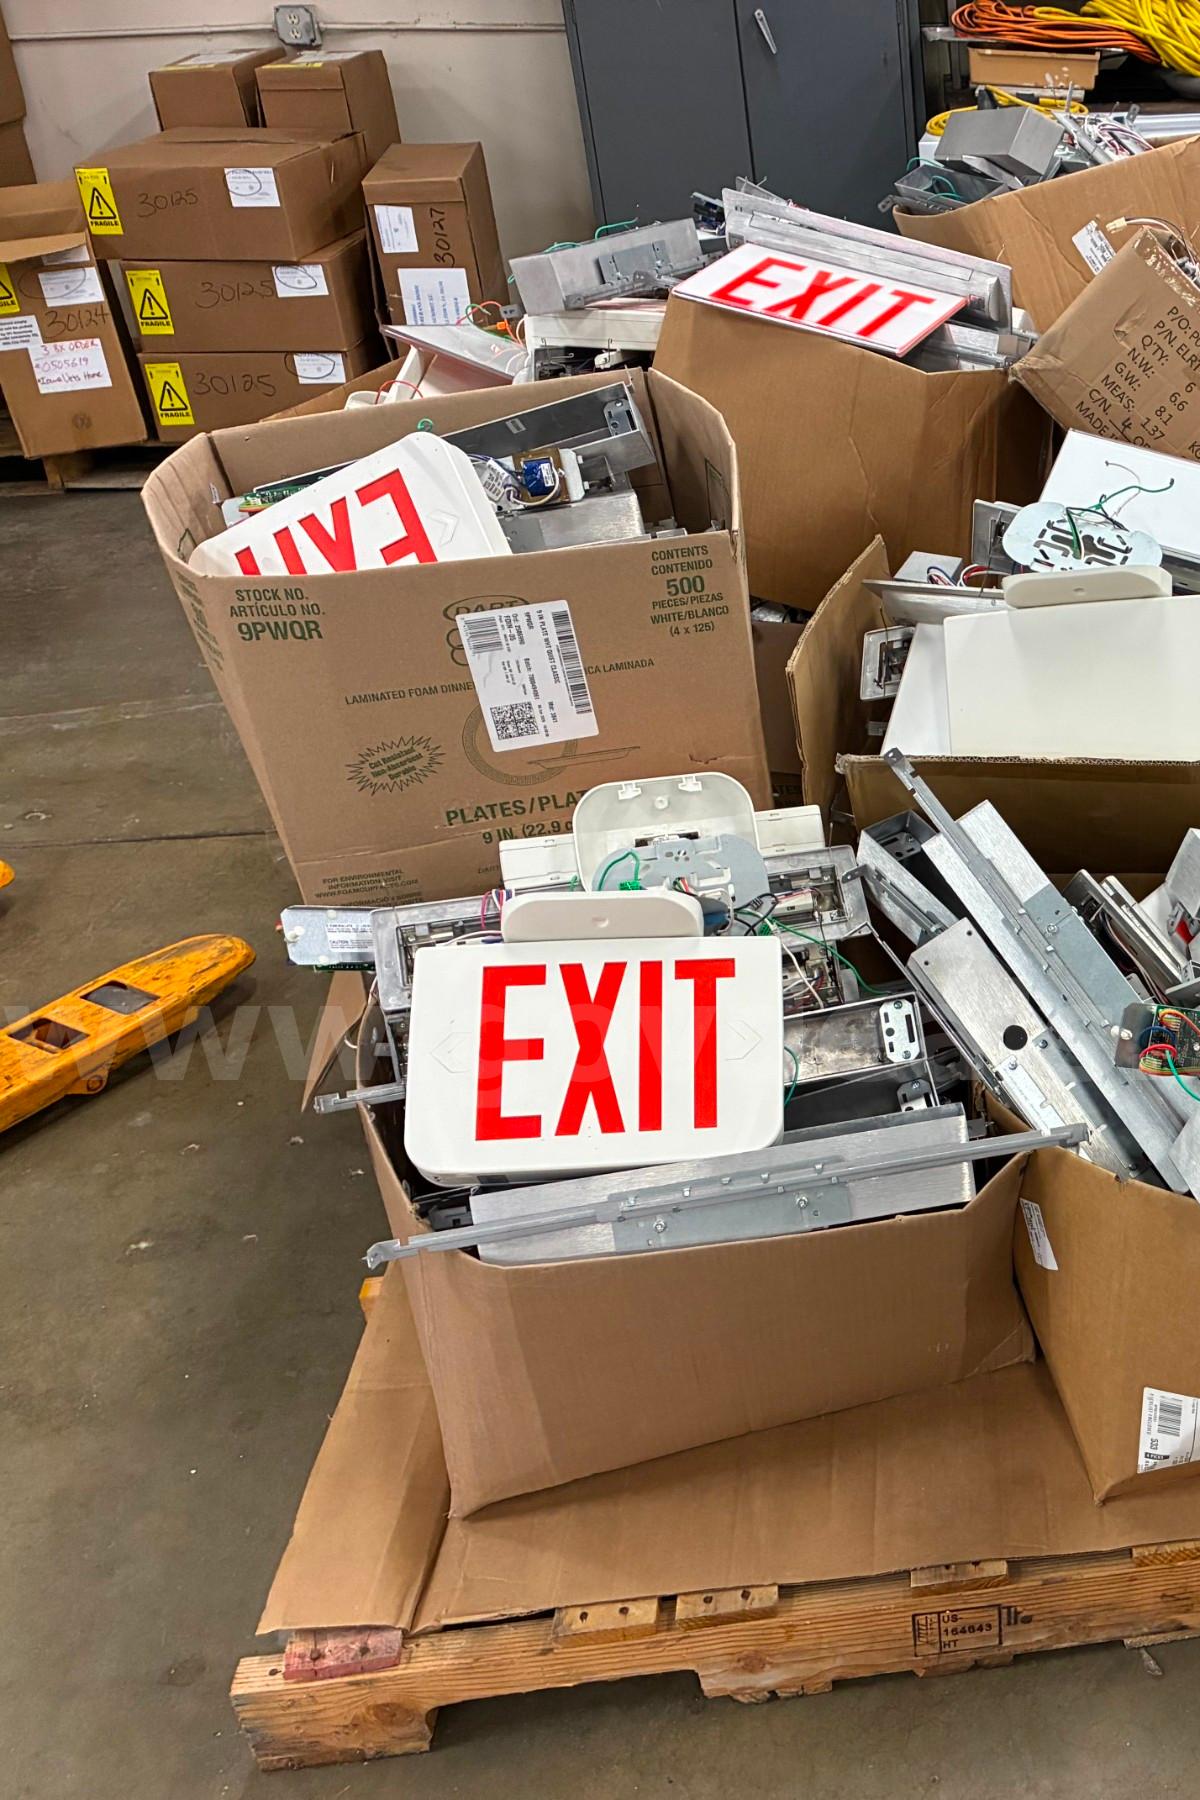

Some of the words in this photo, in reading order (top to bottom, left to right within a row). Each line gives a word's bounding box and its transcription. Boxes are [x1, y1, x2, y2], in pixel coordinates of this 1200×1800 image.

[137, 191, 198, 217] 30125
[430, 207, 455, 268] 30127
[196, 281, 275, 308] 30125
[710, 257, 934, 337] EXIT
[43, 303, 110, 338] 30124
[193, 371, 277, 397] 30125
[1184, 381, 1197, 394] 6
[1168, 391, 1189, 413] 6.6
[1075, 400, 1109, 435] MADE
[1154, 405, 1175, 427] 8.1
[1140, 416, 1166, 442] 1.37
[234, 469, 437, 576] EX
[651, 545, 709, 561] CONTENTS
[651, 558, 713, 576] CONTENIDO
[235, 588, 281, 601] STOCK
[284, 588, 309, 601] NO.
[666, 575, 705, 596] 500
[230, 602, 297, 618] ARTÍCULO
[301, 603, 326, 616] NO.
[456, 600, 518, 615] DAR
[651, 592, 724, 610] PIECES/PIEZAS
[650, 605, 729, 625] WHITE/BLANCO
[237, 620, 323, 641] 9PWQR
[694, 620, 715, 632] 125)
[603, 658, 655, 674] LAMINADA
[344, 684, 406, 705] LAMINATED
[408, 684, 439, 698] FOAM
[441, 681, 476, 695] DINNE
[482, 831, 493, 845] 9
[328, 879, 380, 890] INFORMATION
[340, 869, 404, 881] ENVIRONMENTAL
[475, 958, 736, 1141] EXIT
[943, 1640, 959, 1649] HT
